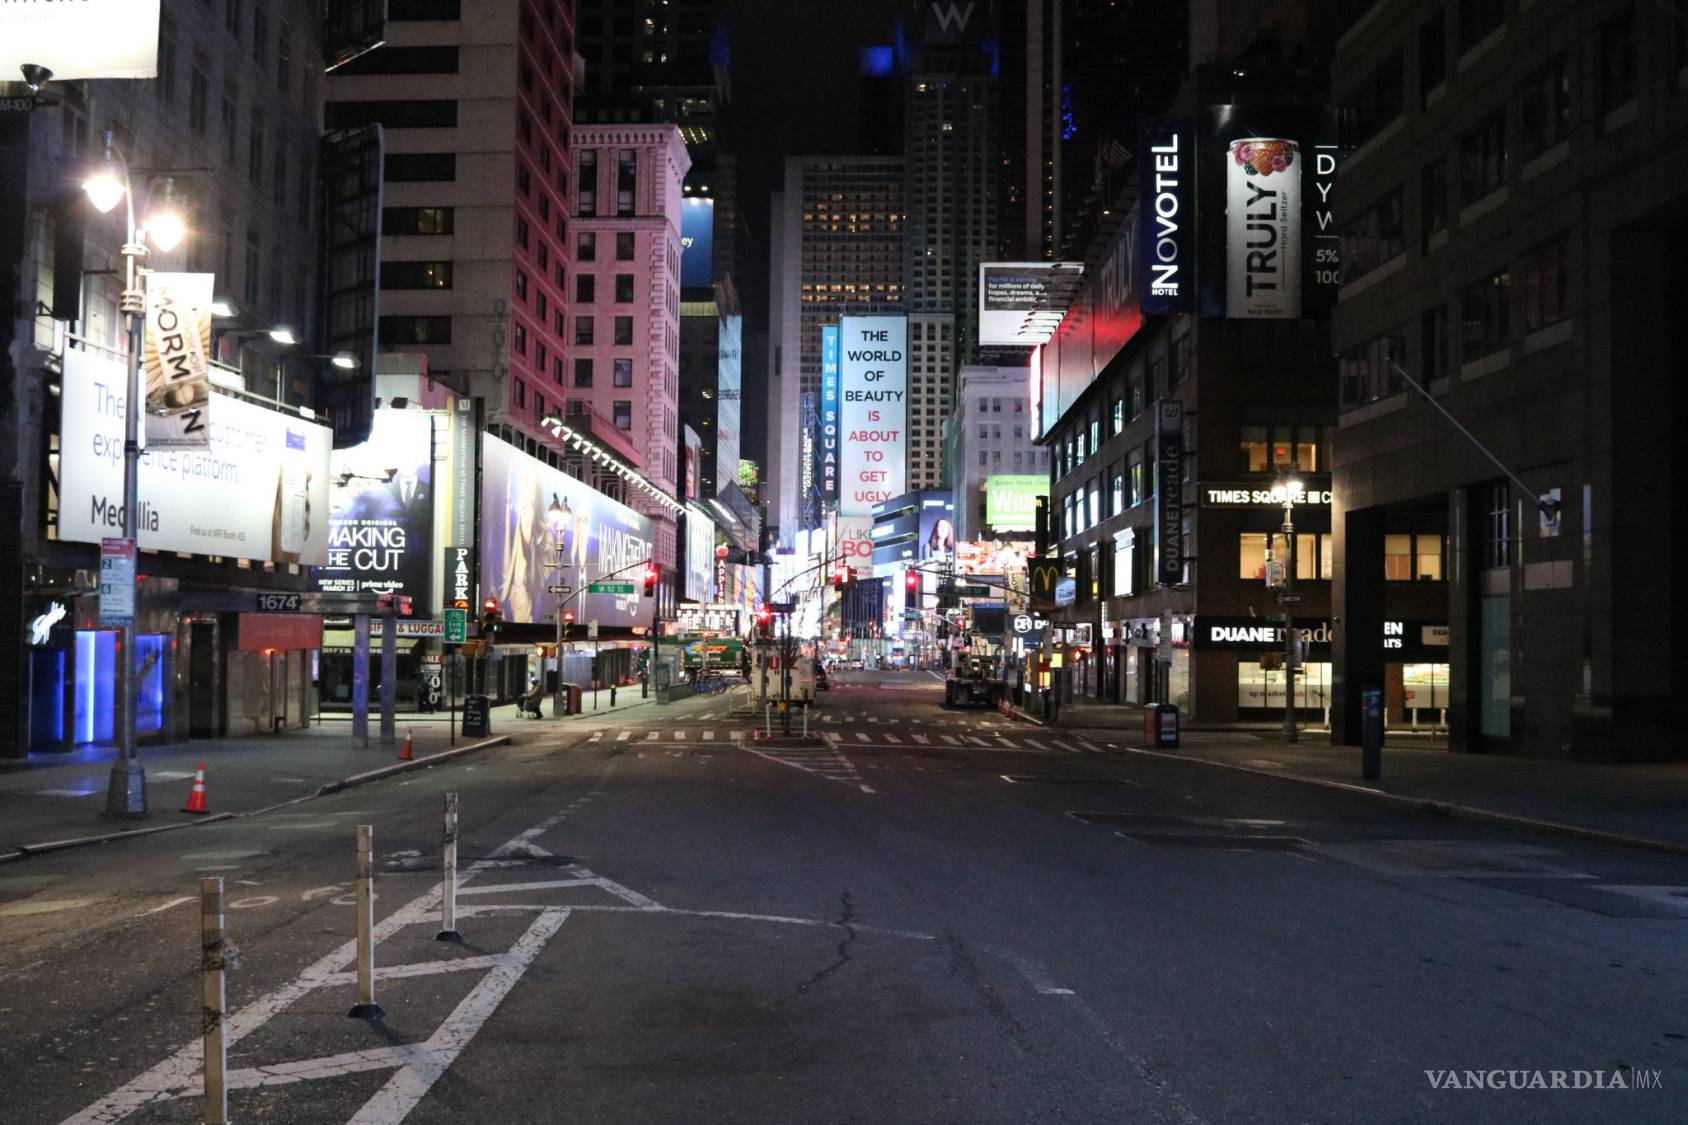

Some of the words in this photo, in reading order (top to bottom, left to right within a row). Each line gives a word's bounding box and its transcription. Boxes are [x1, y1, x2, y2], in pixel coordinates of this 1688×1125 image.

[931, 2, 975, 32] W
[1152, 134, 1178, 288] NOVOTEL
[1246, 181, 1277, 297] TRULY
[1316, 250, 1338, 263] 5%
[861, 330, 888, 342] THE
[848, 351, 901, 362] WORLD
[825, 336, 836, 401] TIMES
[864, 370, 884, 382] OF
[94, 383, 126, 419] The
[845, 391, 903, 402] BEAUTY
[868, 411, 880, 422] IS
[849, 431, 899, 442] ABOUT
[825, 411, 836, 491] SQUARE
[864, 451, 883, 462] TO
[859, 471, 887, 482] GET
[855, 491, 891, 502] UGLY
[1208, 490, 1250, 503] TIMES
[1252, 490, 1306, 504] SQUARE
[91, 495, 159, 532] Medllia
[328, 553, 348, 566] HE
[355, 549, 404, 571] CUT
[455, 549, 469, 600] PARK
[362, 581, 382, 589] prime
[383, 580, 404, 588] video
[259, 595, 297, 610] 1674
[398, 624, 405, 633] &
